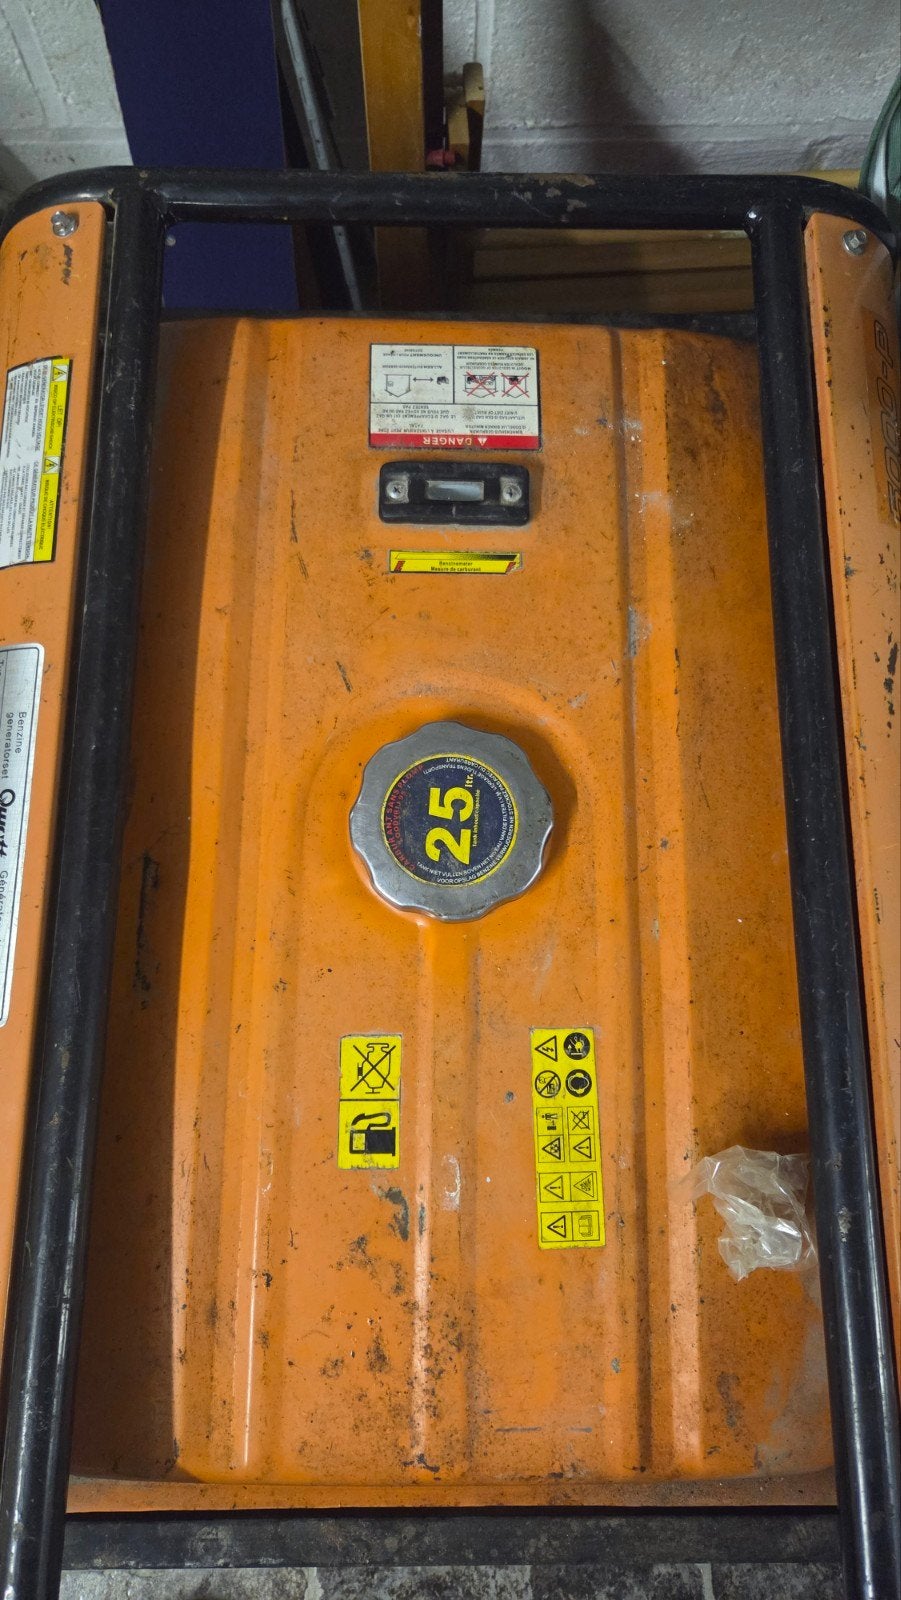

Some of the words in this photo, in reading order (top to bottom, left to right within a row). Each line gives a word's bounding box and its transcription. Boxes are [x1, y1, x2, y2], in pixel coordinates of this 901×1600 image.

[422, 437, 472, 446] DANGER
[14, 711, 27, 754] Benzine
[1, 712, 15, 780] generatorset
[496, 781, 504, 791] PAS
[503, 791, 514, 815] STOCKEZ
[425, 786, 474, 865] 25
[464, 774, 473, 788] ltr.
[499, 830, 507, 841] VAN
